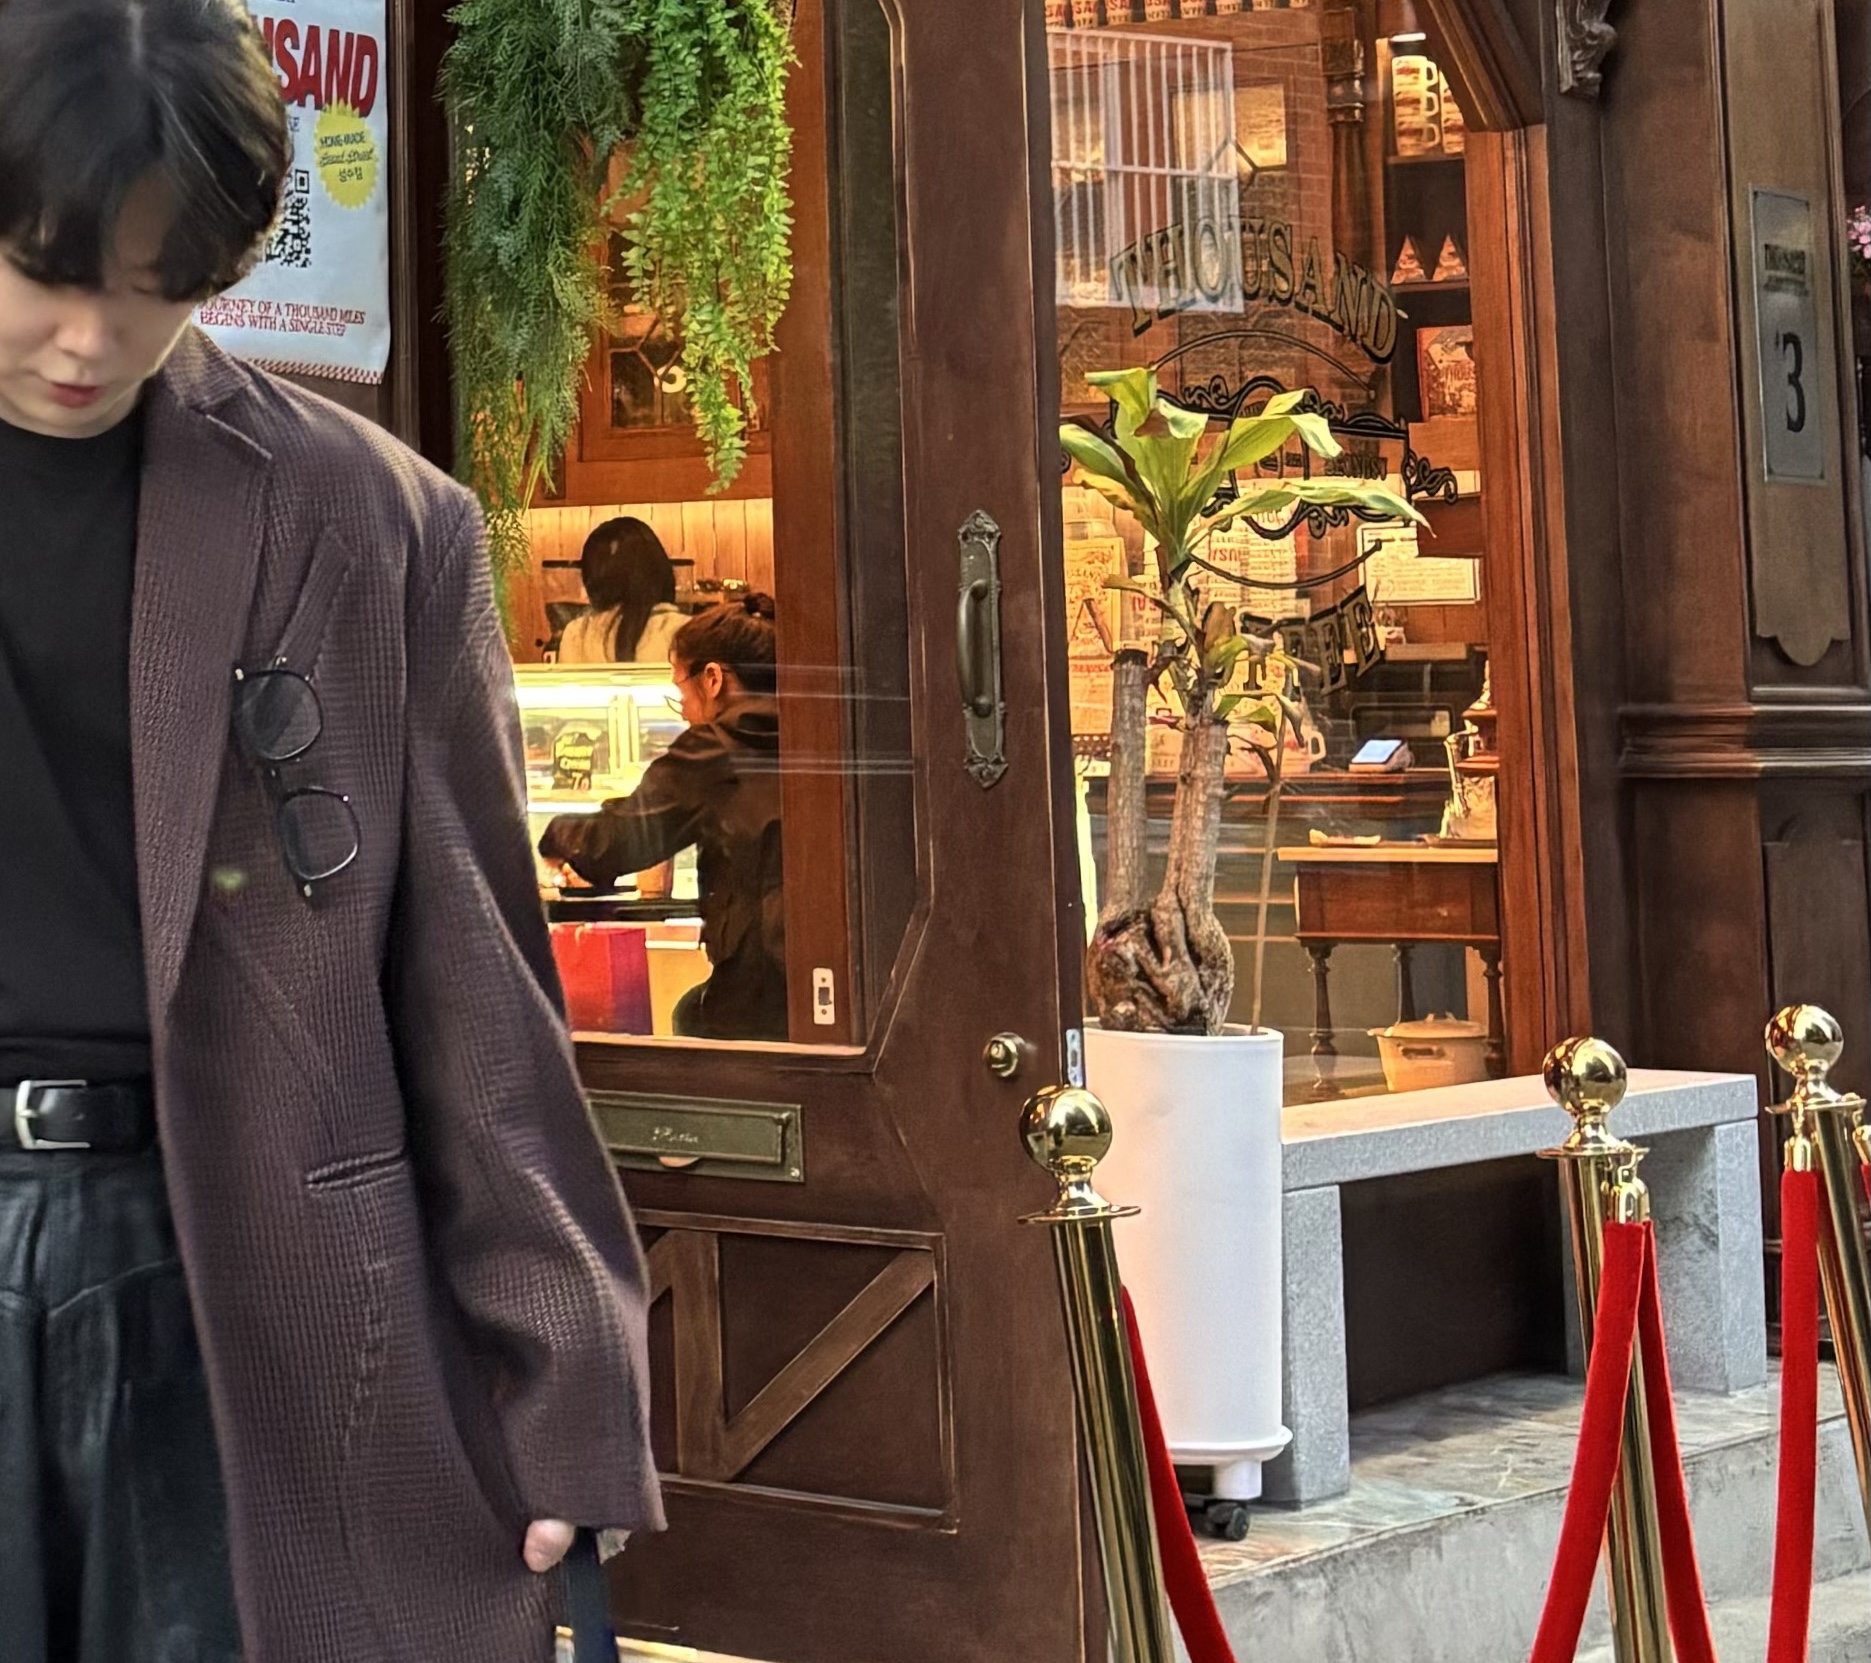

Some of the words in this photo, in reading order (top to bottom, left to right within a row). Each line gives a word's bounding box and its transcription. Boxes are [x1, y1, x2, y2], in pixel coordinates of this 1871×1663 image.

[1109, 216, 1398, 366] THOUSAND
[204, 297, 256, 315] OURNEY
[258, 301, 273, 316] OF
[276, 302, 283, 317] A
[285, 304, 338, 322] THOUSAND
[339, 308, 366, 325] MILES
[247, 315, 277, 332] WITH
[279, 318, 287, 333] A
[289, 319, 325, 335] SINGLE
